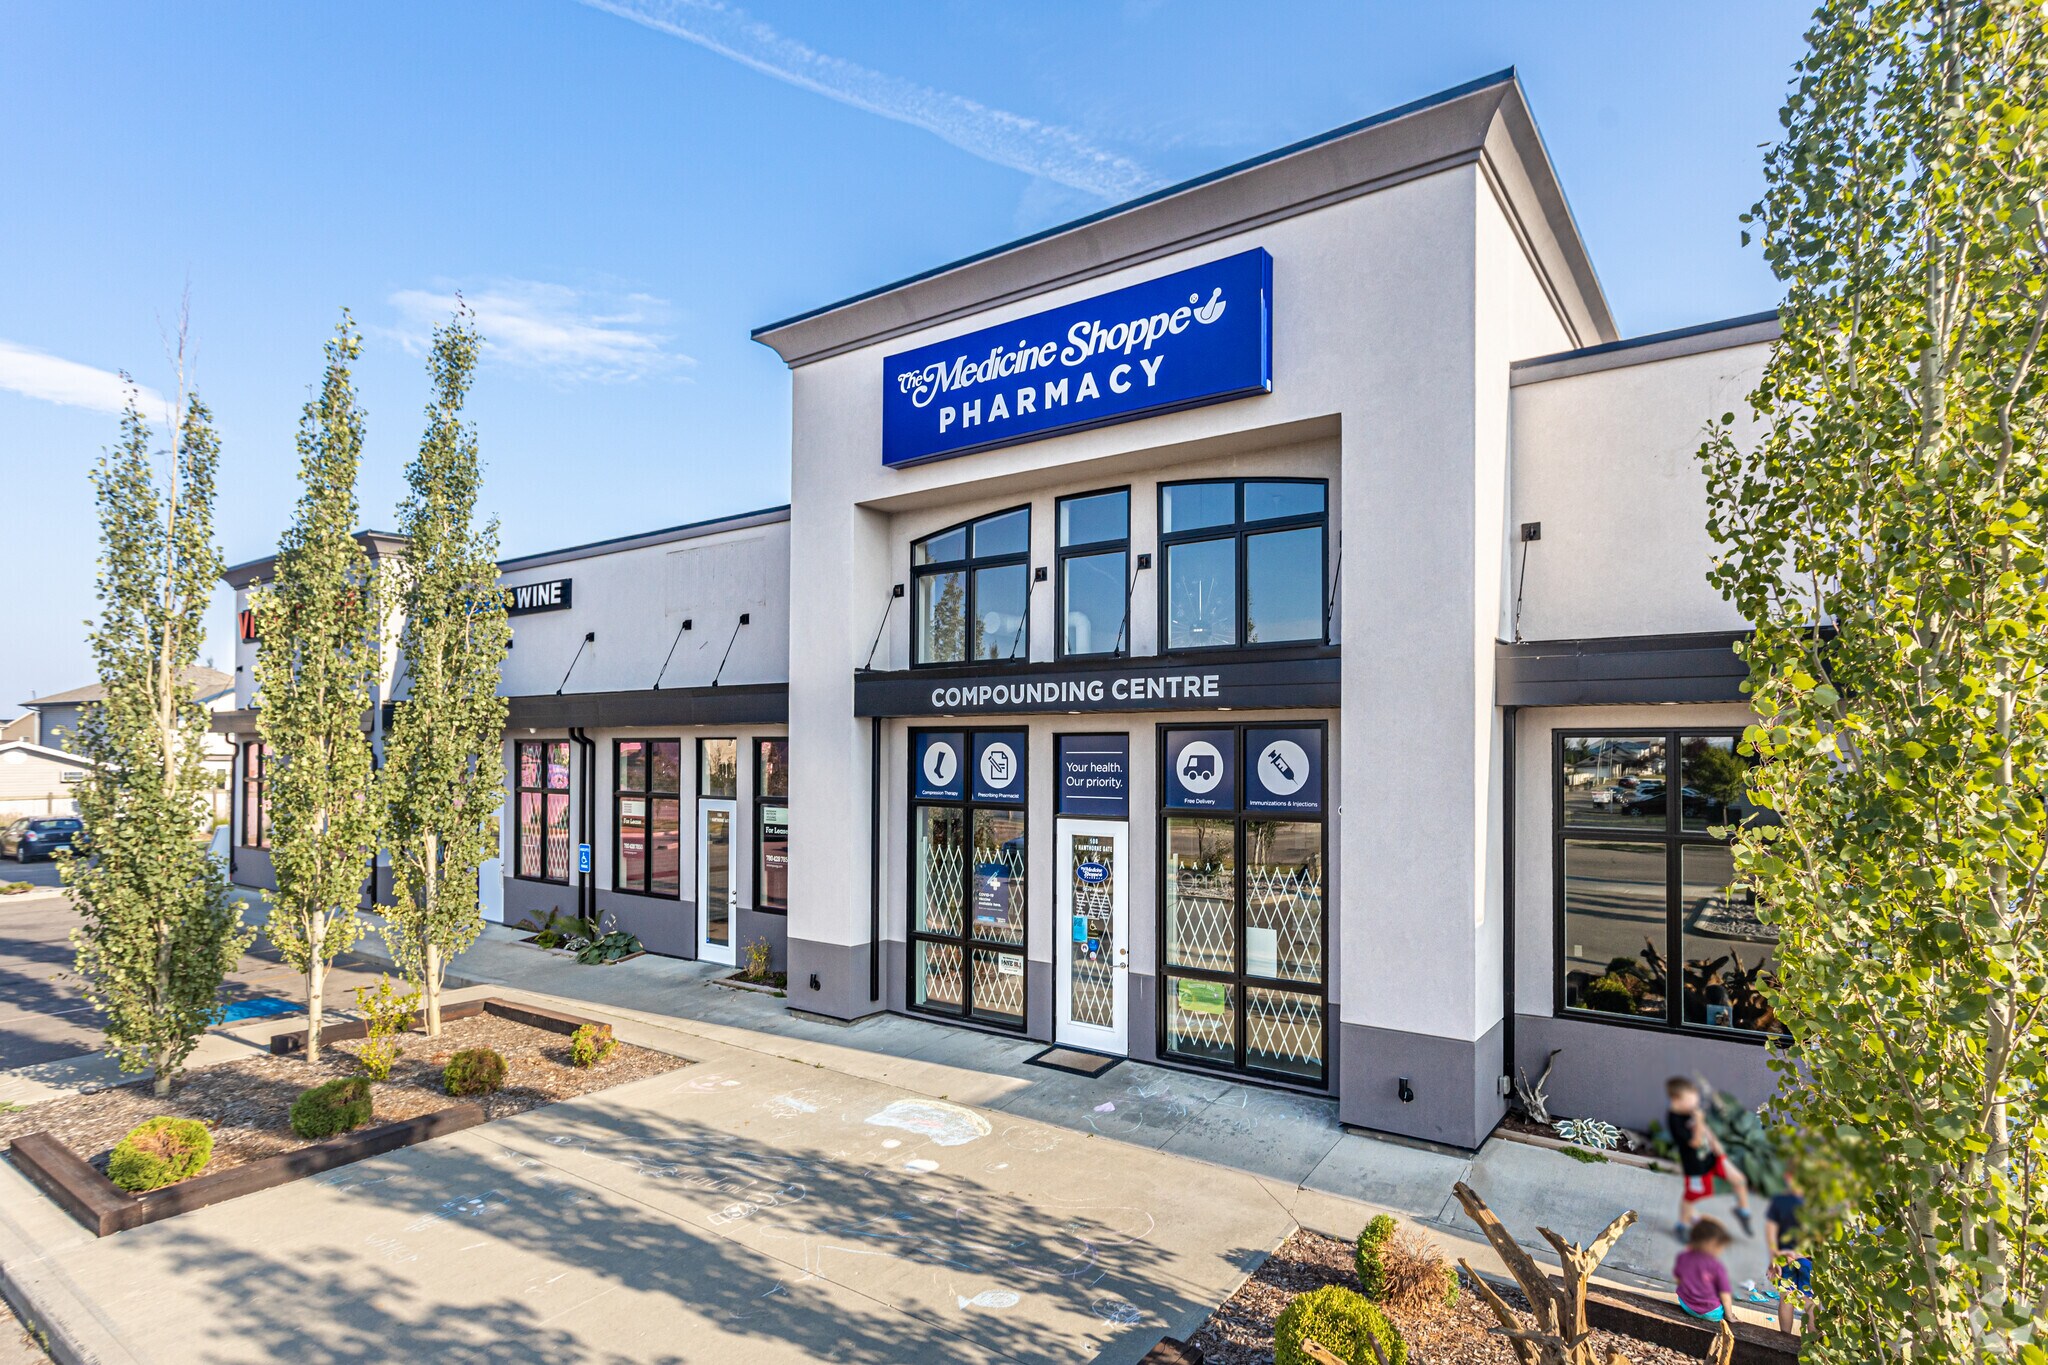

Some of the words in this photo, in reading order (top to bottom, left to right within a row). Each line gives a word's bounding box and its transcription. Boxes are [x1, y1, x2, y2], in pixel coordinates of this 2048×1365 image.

[898, 371, 923, 394] The
[912, 339, 1057, 408] Medicine
[1061, 307, 1192, 367] Shoppe
[939, 354, 1165, 434] PHARMACY
[516, 582, 562, 609] WINE
[931, 680, 1105, 708] COMPOUNDING
[1112, 674, 1221, 700] CENTRE
[1066, 762, 1088, 773] Your
[1090, 762, 1123, 773] health.
[1066, 776, 1084, 787] Our
[1086, 776, 1123, 789] priority.
[921, 789, 944, 797] Compression
[944, 790, 959, 798] Therapy
[1195, 798, 1216, 806] Delivery
[765, 826, 774, 834] For
[1102, 845, 1113, 853] GATE
